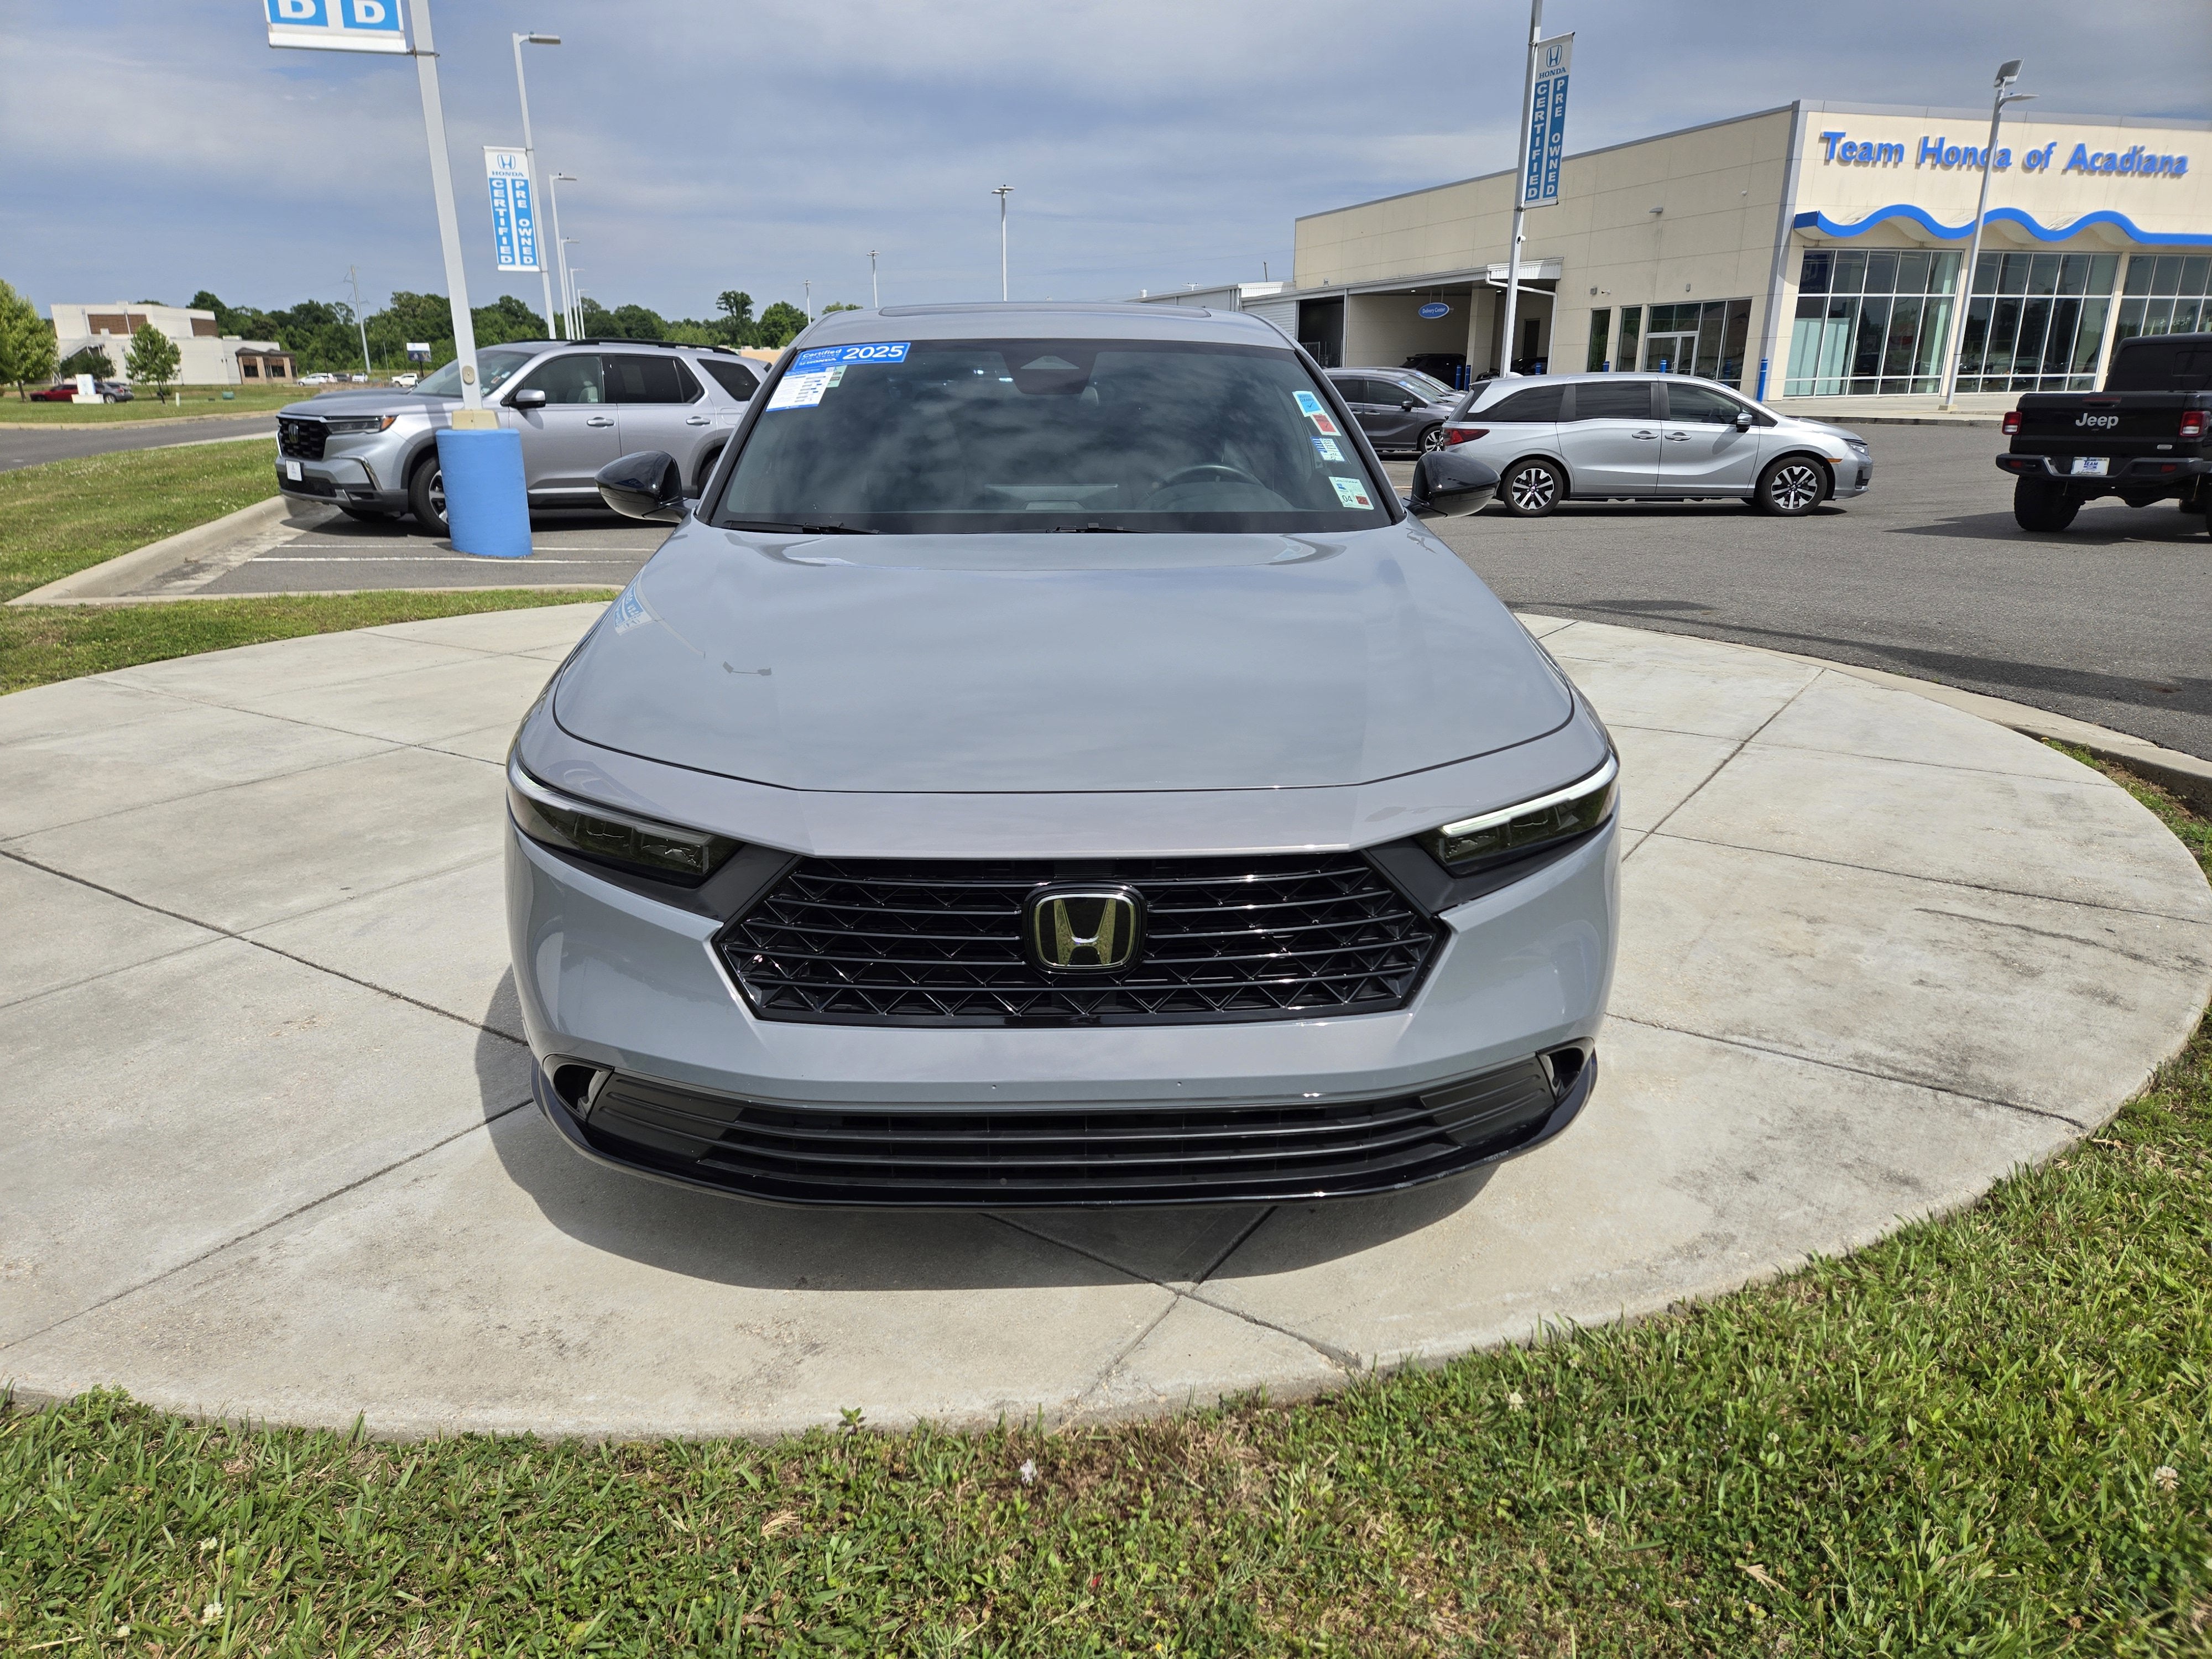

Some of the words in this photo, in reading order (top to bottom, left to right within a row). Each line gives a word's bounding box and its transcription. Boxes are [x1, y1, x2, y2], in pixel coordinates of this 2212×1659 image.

[1539, 67, 1567, 79] HONDA
[1554, 79, 1565, 118] PRE
[1527, 84, 1547, 199] CERTIFIED
[1822, 131, 1905, 163] Team
[2024, 141, 2058, 169] of
[2064, 143, 2189, 175] Acadiana
[1546, 133, 1561, 195] OWNED
[515, 180, 528, 208] PRE
[492, 179, 513, 264] CERTIFIED
[518, 218, 534, 264] OWNED
[802, 348, 842, 358] Certified
[842, 346, 905, 360] 2025
[2075, 413, 2119, 429] Jeep
